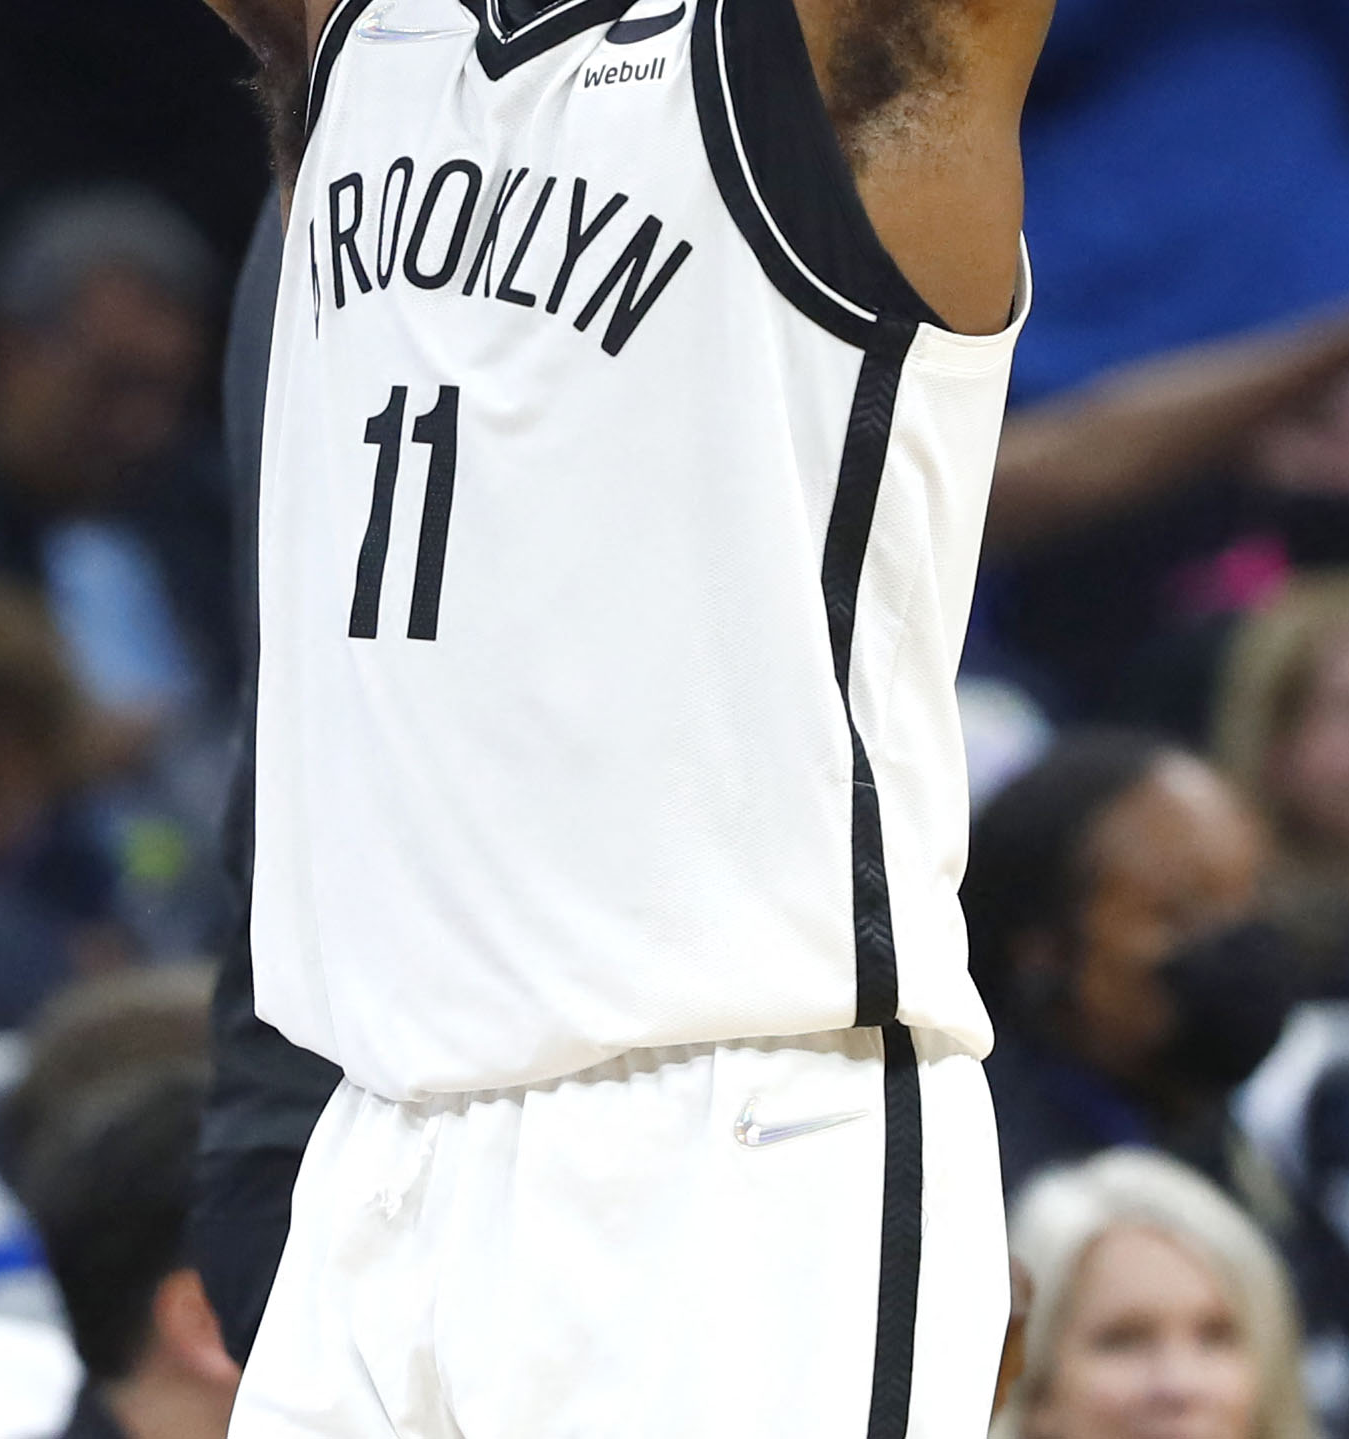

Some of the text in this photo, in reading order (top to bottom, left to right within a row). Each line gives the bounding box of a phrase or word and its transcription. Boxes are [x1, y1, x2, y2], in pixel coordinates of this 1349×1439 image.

[584, 57, 666, 88] Webull
[310, 156, 693, 357] ROOKLYN
[348, 385, 460, 641] 11
